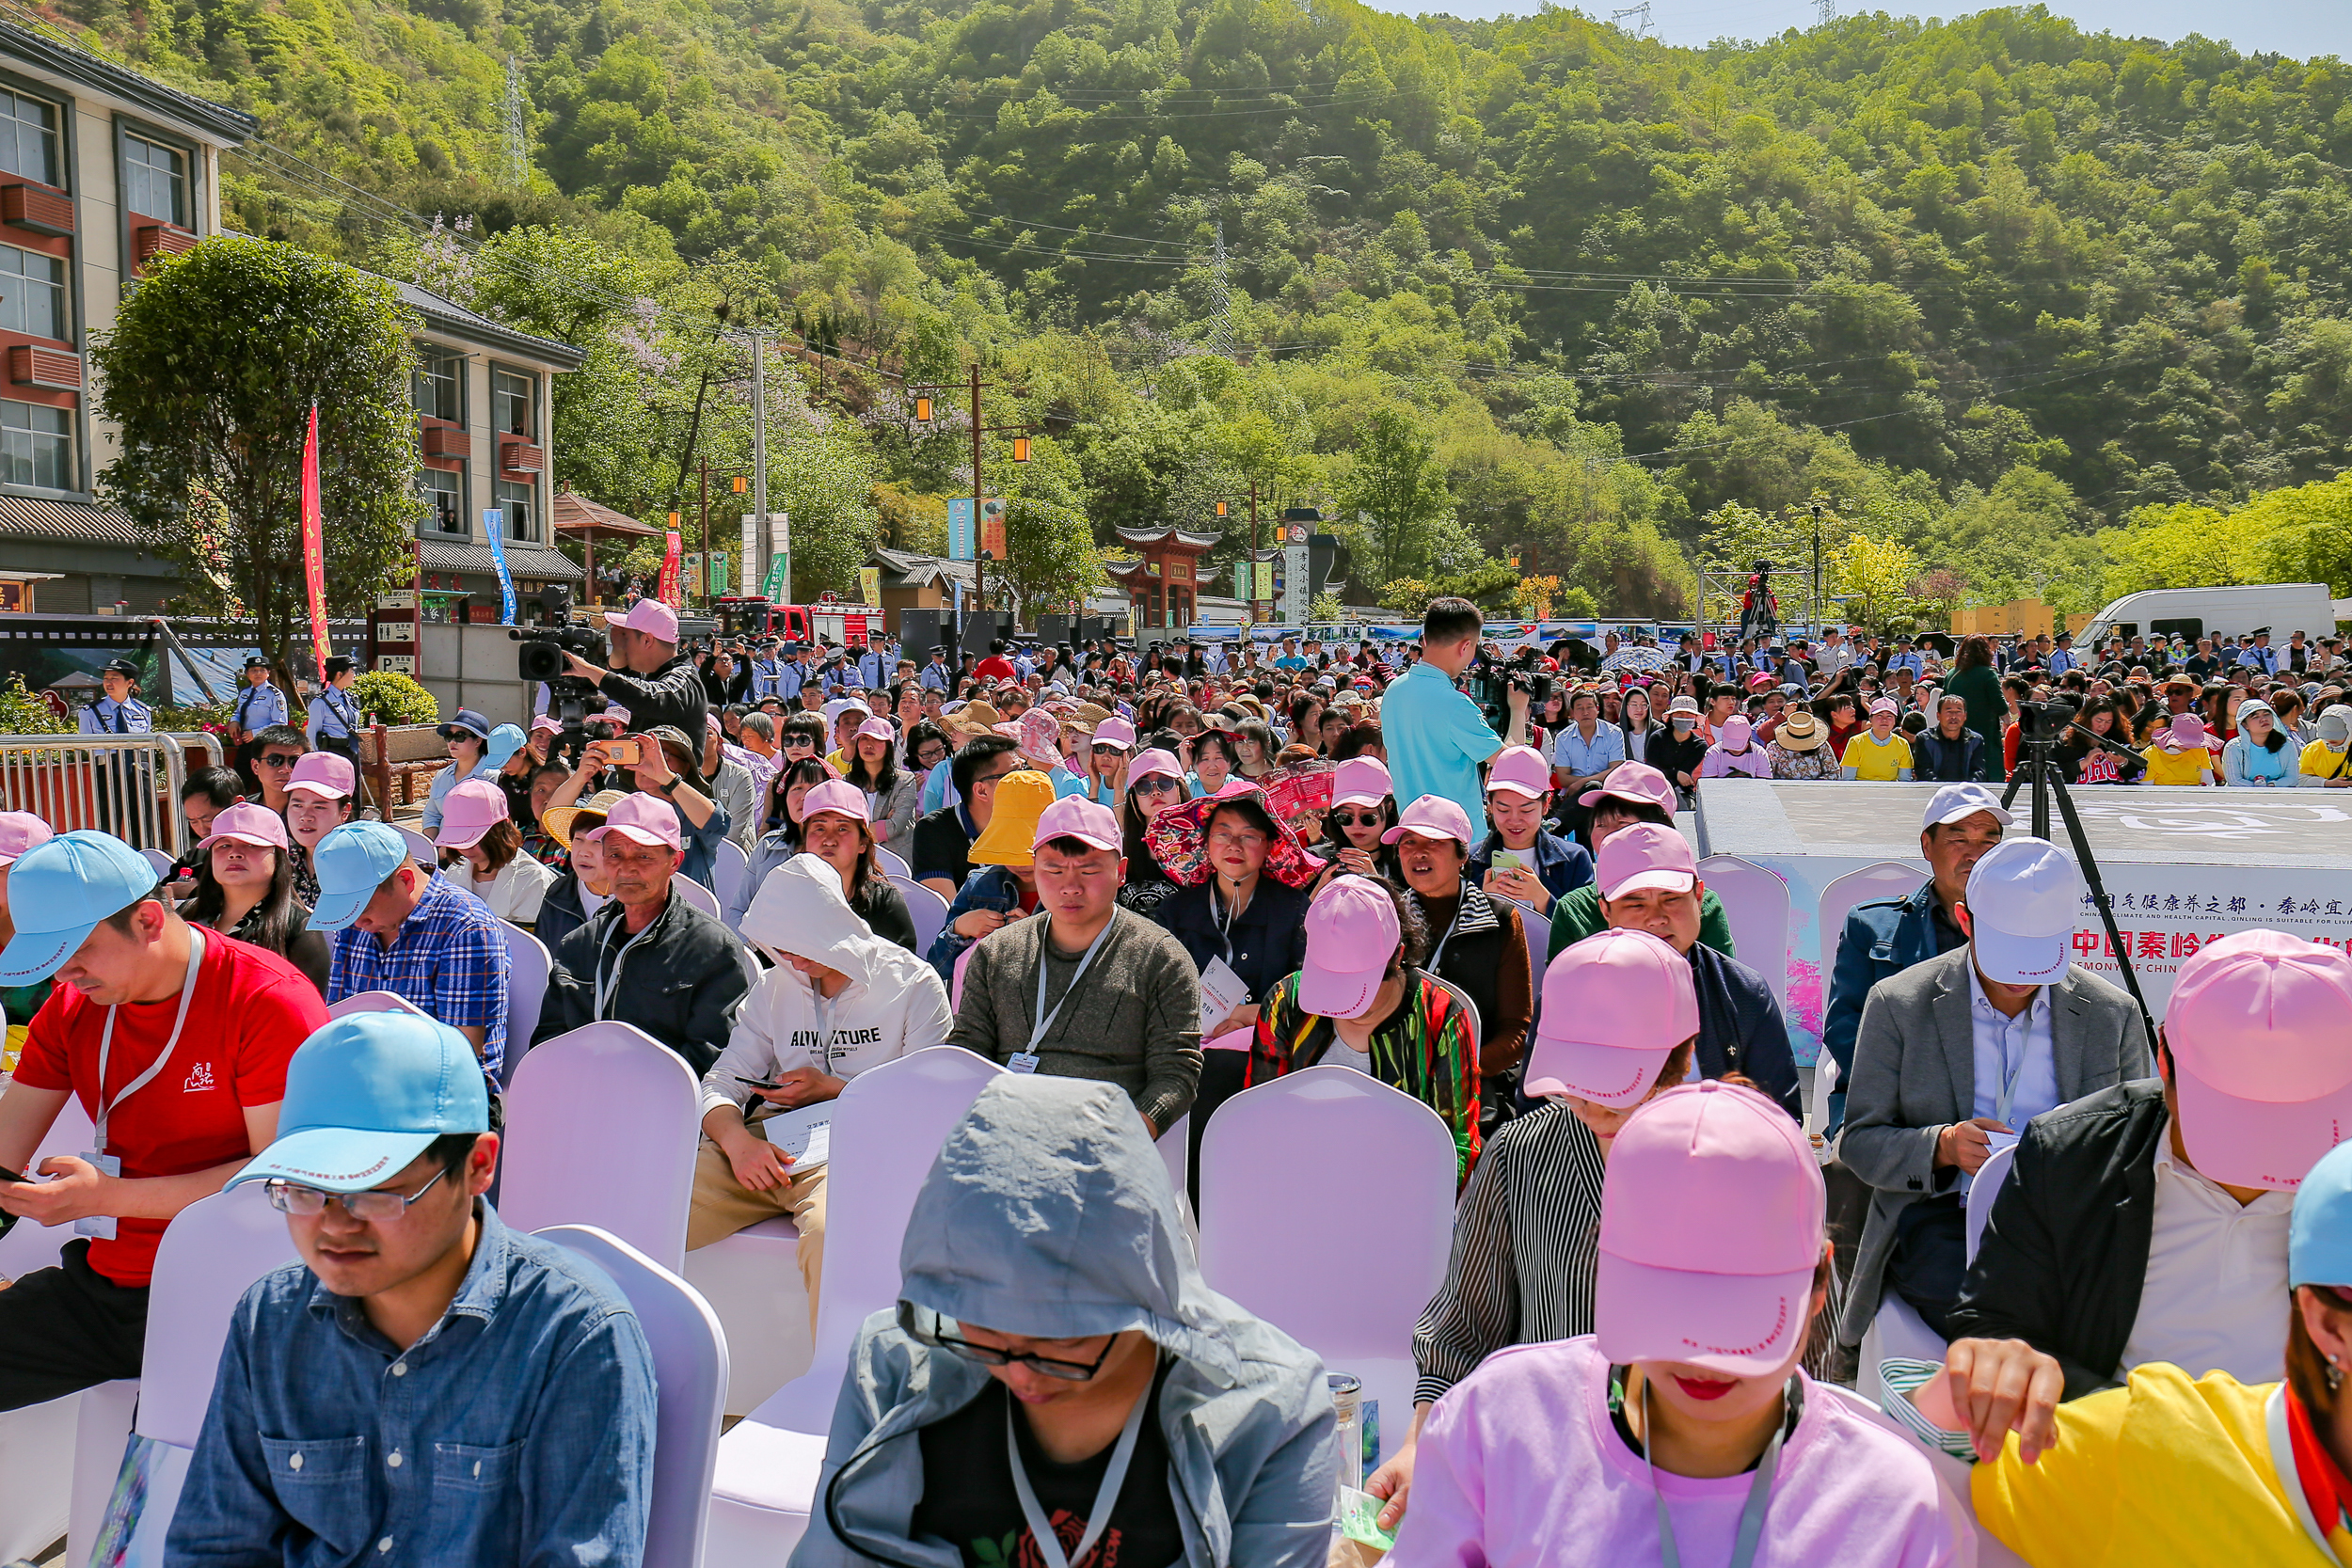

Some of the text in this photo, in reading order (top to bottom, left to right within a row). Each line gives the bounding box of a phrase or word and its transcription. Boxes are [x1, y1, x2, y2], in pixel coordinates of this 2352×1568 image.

[383, 657, 392, 673] P
[2072, 961, 2121, 972] EMONY
[2146, 964, 2177, 974] CHIN
[790, 1027, 882, 1047] ADVNTURE
